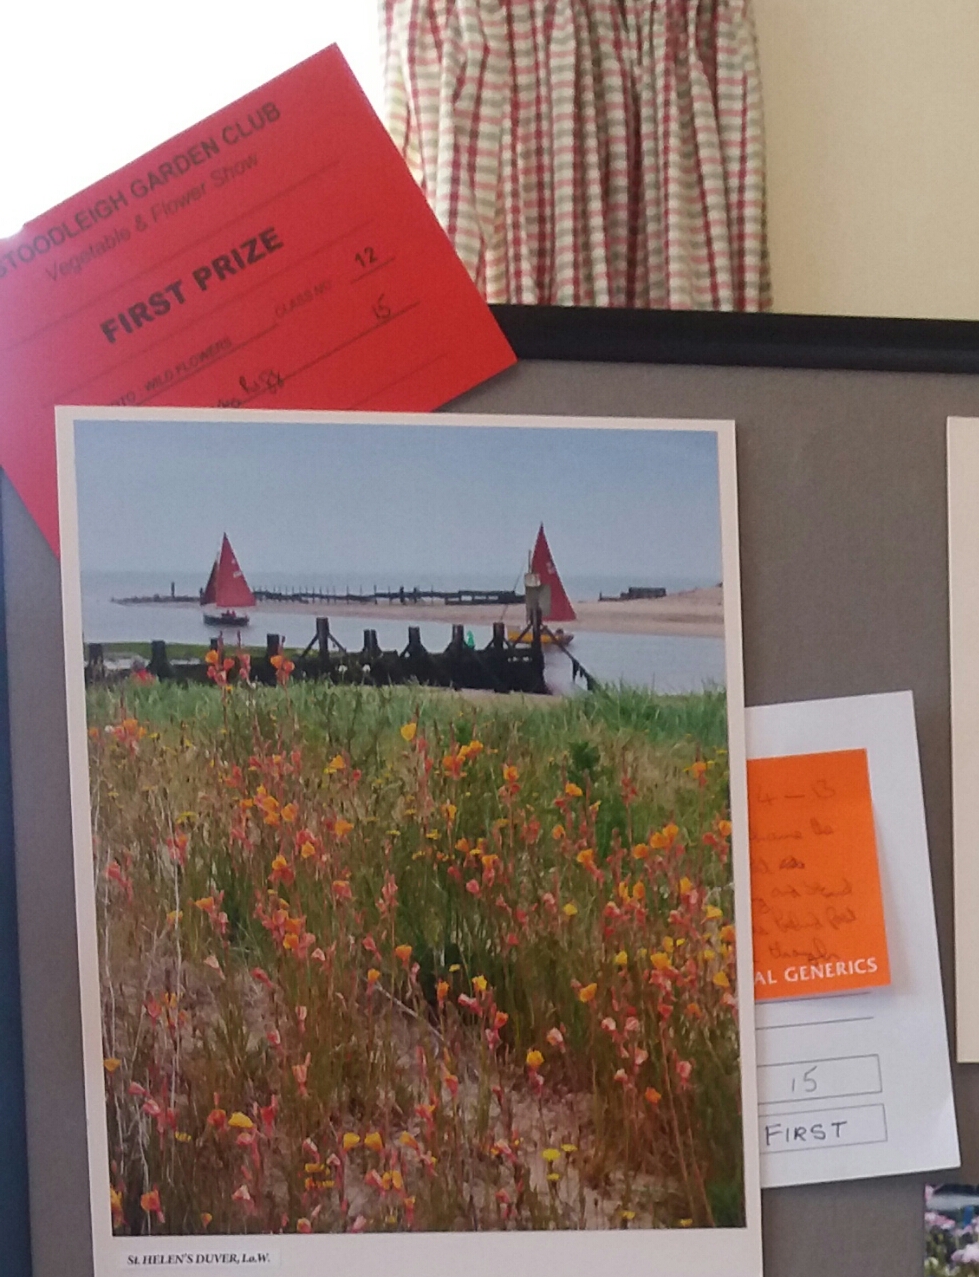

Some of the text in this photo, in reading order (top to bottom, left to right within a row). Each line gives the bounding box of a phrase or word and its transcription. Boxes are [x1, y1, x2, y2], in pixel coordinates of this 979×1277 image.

[130, 138, 220, 199] GARDEN
[221, 101, 281, 146] CLUB
[45, 152, 259, 281] Vegetable & Flower Show
[355, 246, 377, 268] 12
[100, 226, 285, 345] FIRST PRIZE
[784, 957, 879, 983] GENERICS
[791, 1065, 818, 1093] 15
[765, 1120, 848, 1147] FIRST
